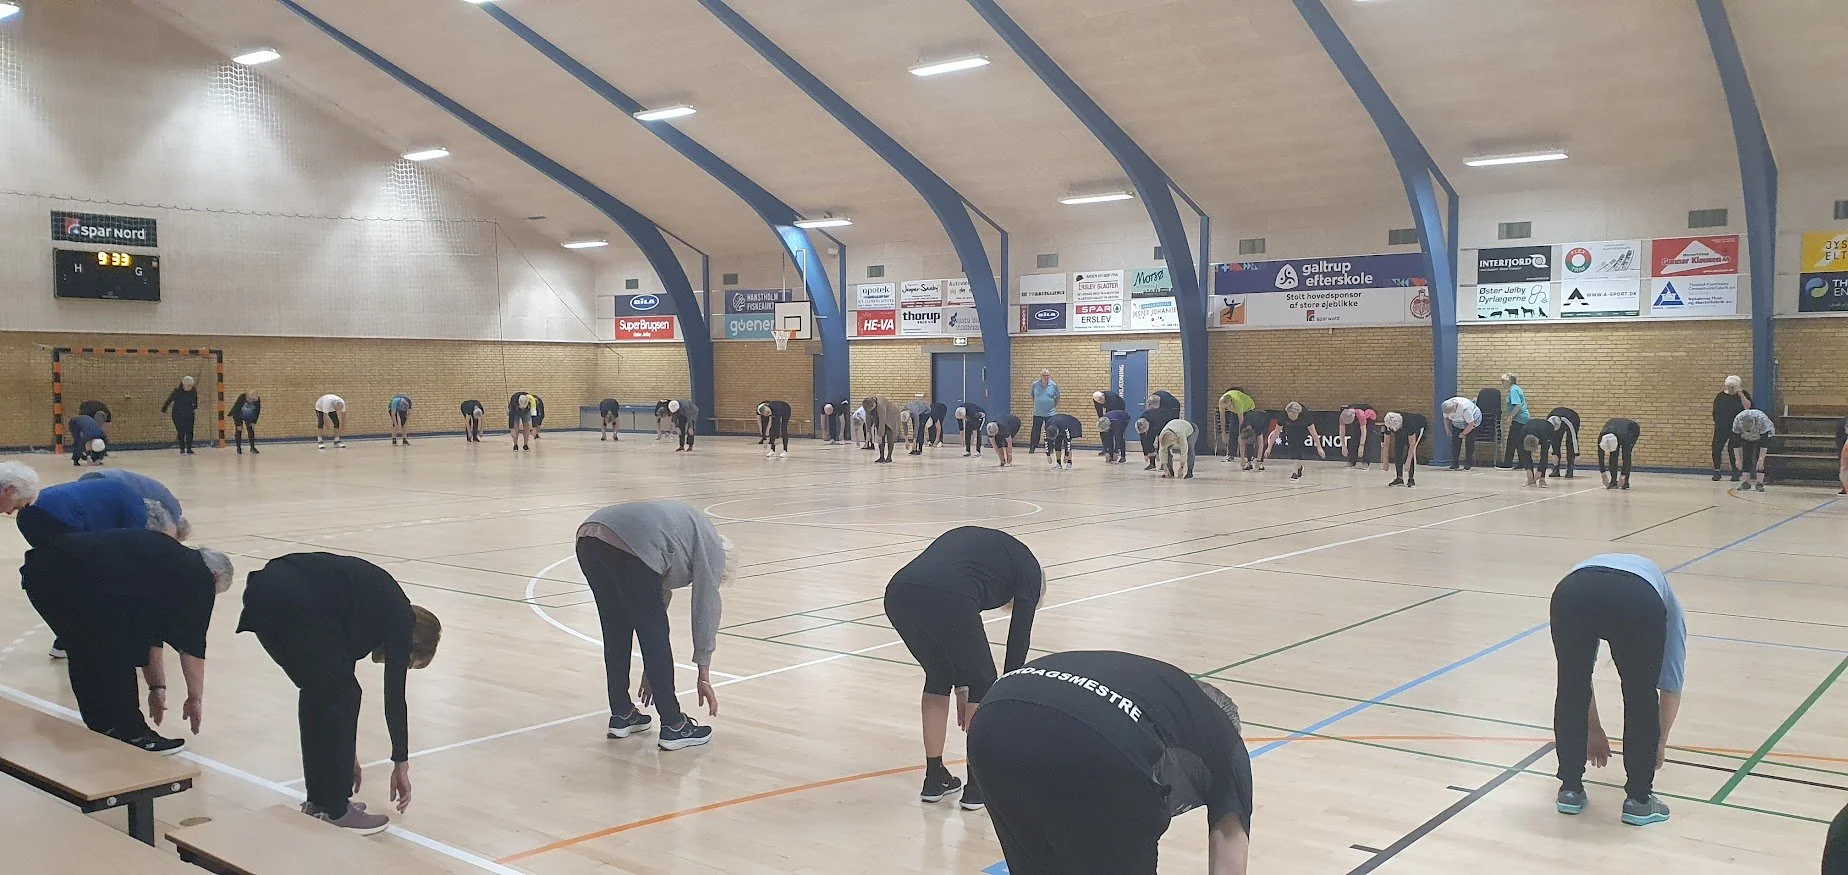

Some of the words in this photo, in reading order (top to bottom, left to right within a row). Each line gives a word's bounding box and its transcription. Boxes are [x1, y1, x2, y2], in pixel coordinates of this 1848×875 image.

[1480, 258, 1532, 268] INTERFJORD
[74, 263, 82, 273] H
[135, 267, 143, 276] G
[1302, 261, 1351, 275] galtrup
[1306, 272, 1373, 286] efterskole
[1505, 286, 1526, 295] Jølby
[1286, 293, 1305, 301] Stolt
[1307, 292, 1361, 300] hovedsponsor
[1479, 295, 1526, 304] Dyrlægerne
[1081, 305, 1111, 313] SPAR
[1321, 300, 1358, 309] øjeblikke
[902, 311, 941, 323] thorup
[1081, 316, 1112, 324] ERSLEV
[619, 320, 670, 332] SuperBrugsen
[863, 318, 895, 331] HE-VA
